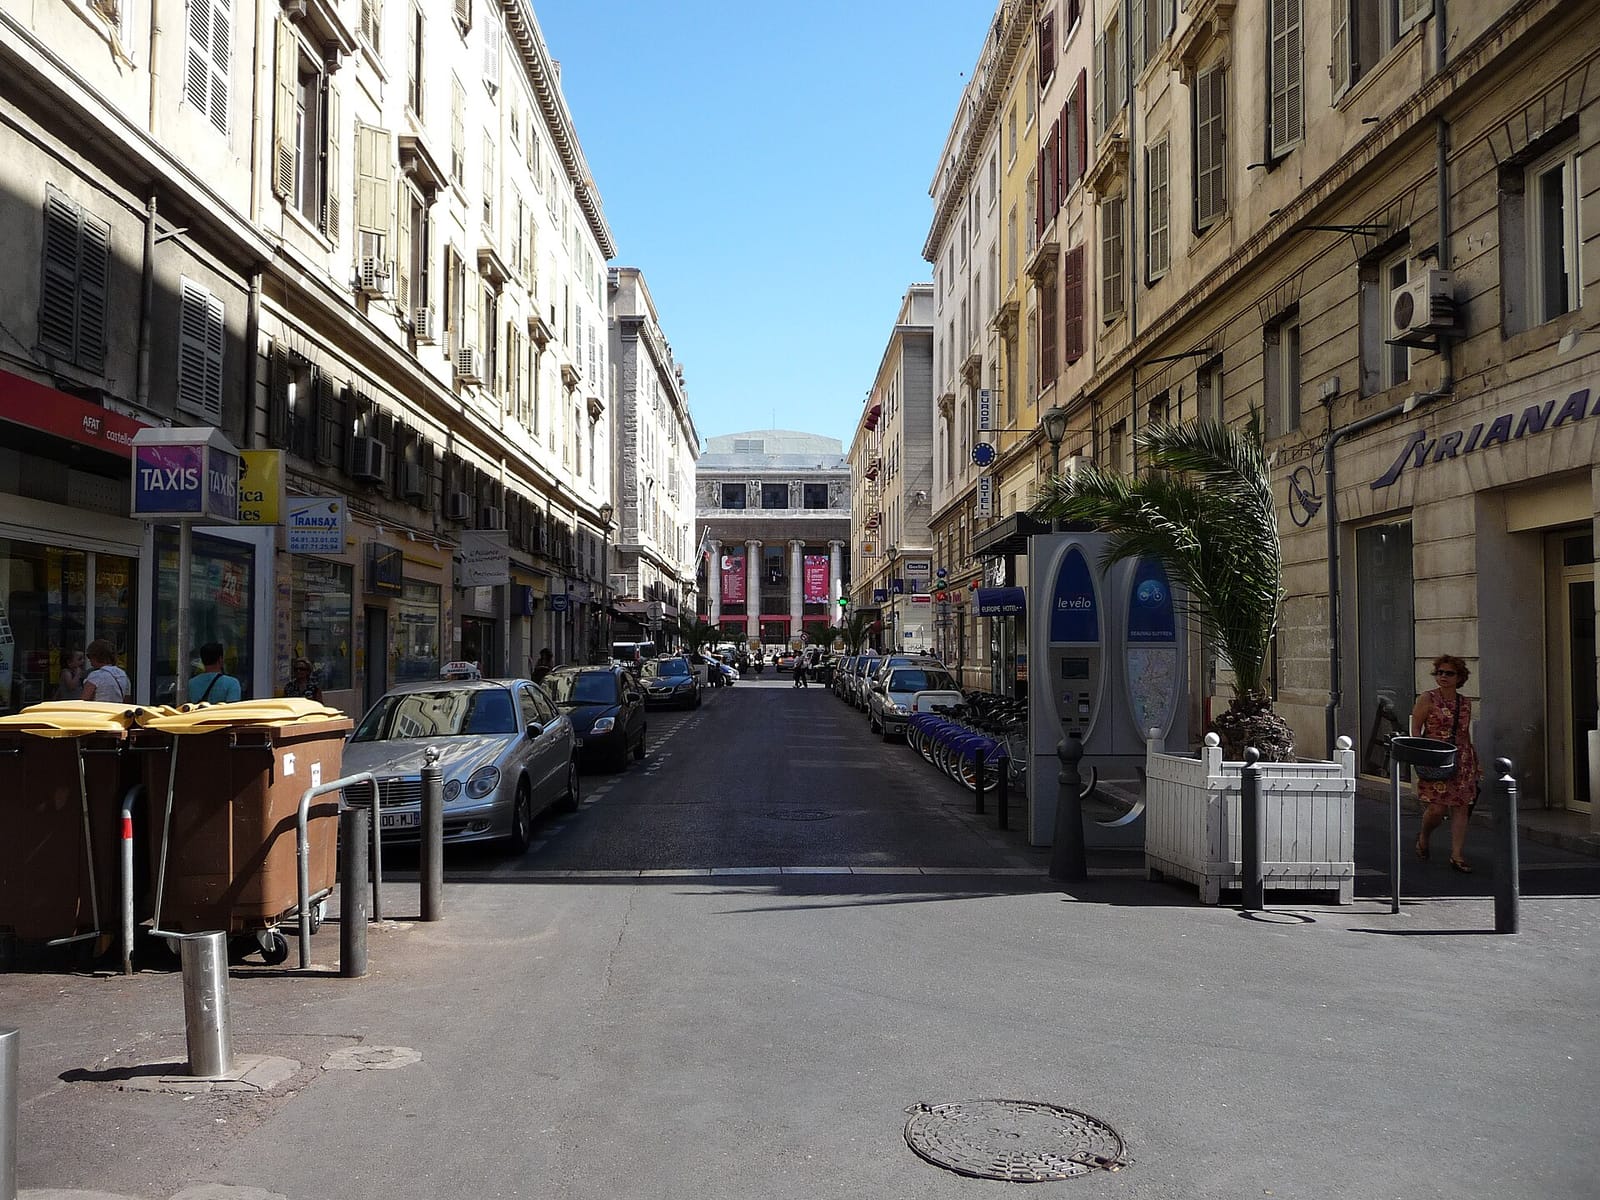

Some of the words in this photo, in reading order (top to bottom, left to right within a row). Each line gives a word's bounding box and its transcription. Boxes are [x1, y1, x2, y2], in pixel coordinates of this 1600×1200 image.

[82, 415, 100, 430] AFAT
[981, 390, 989, 430] EUROPE
[1370, 388, 1600, 490] SYRIANA
[141, 466, 199, 491] TAXIS
[209, 469, 236, 497] TAXIS
[981, 478, 989, 510] HOTEL
[290, 510, 338, 531] TRANSAX
[981, 605, 1001, 613] EUROPE
[1002, 604, 1017, 612] HOTEL
[1057, 597, 1068, 608] le
[1070, 597, 1091, 608] vélo
